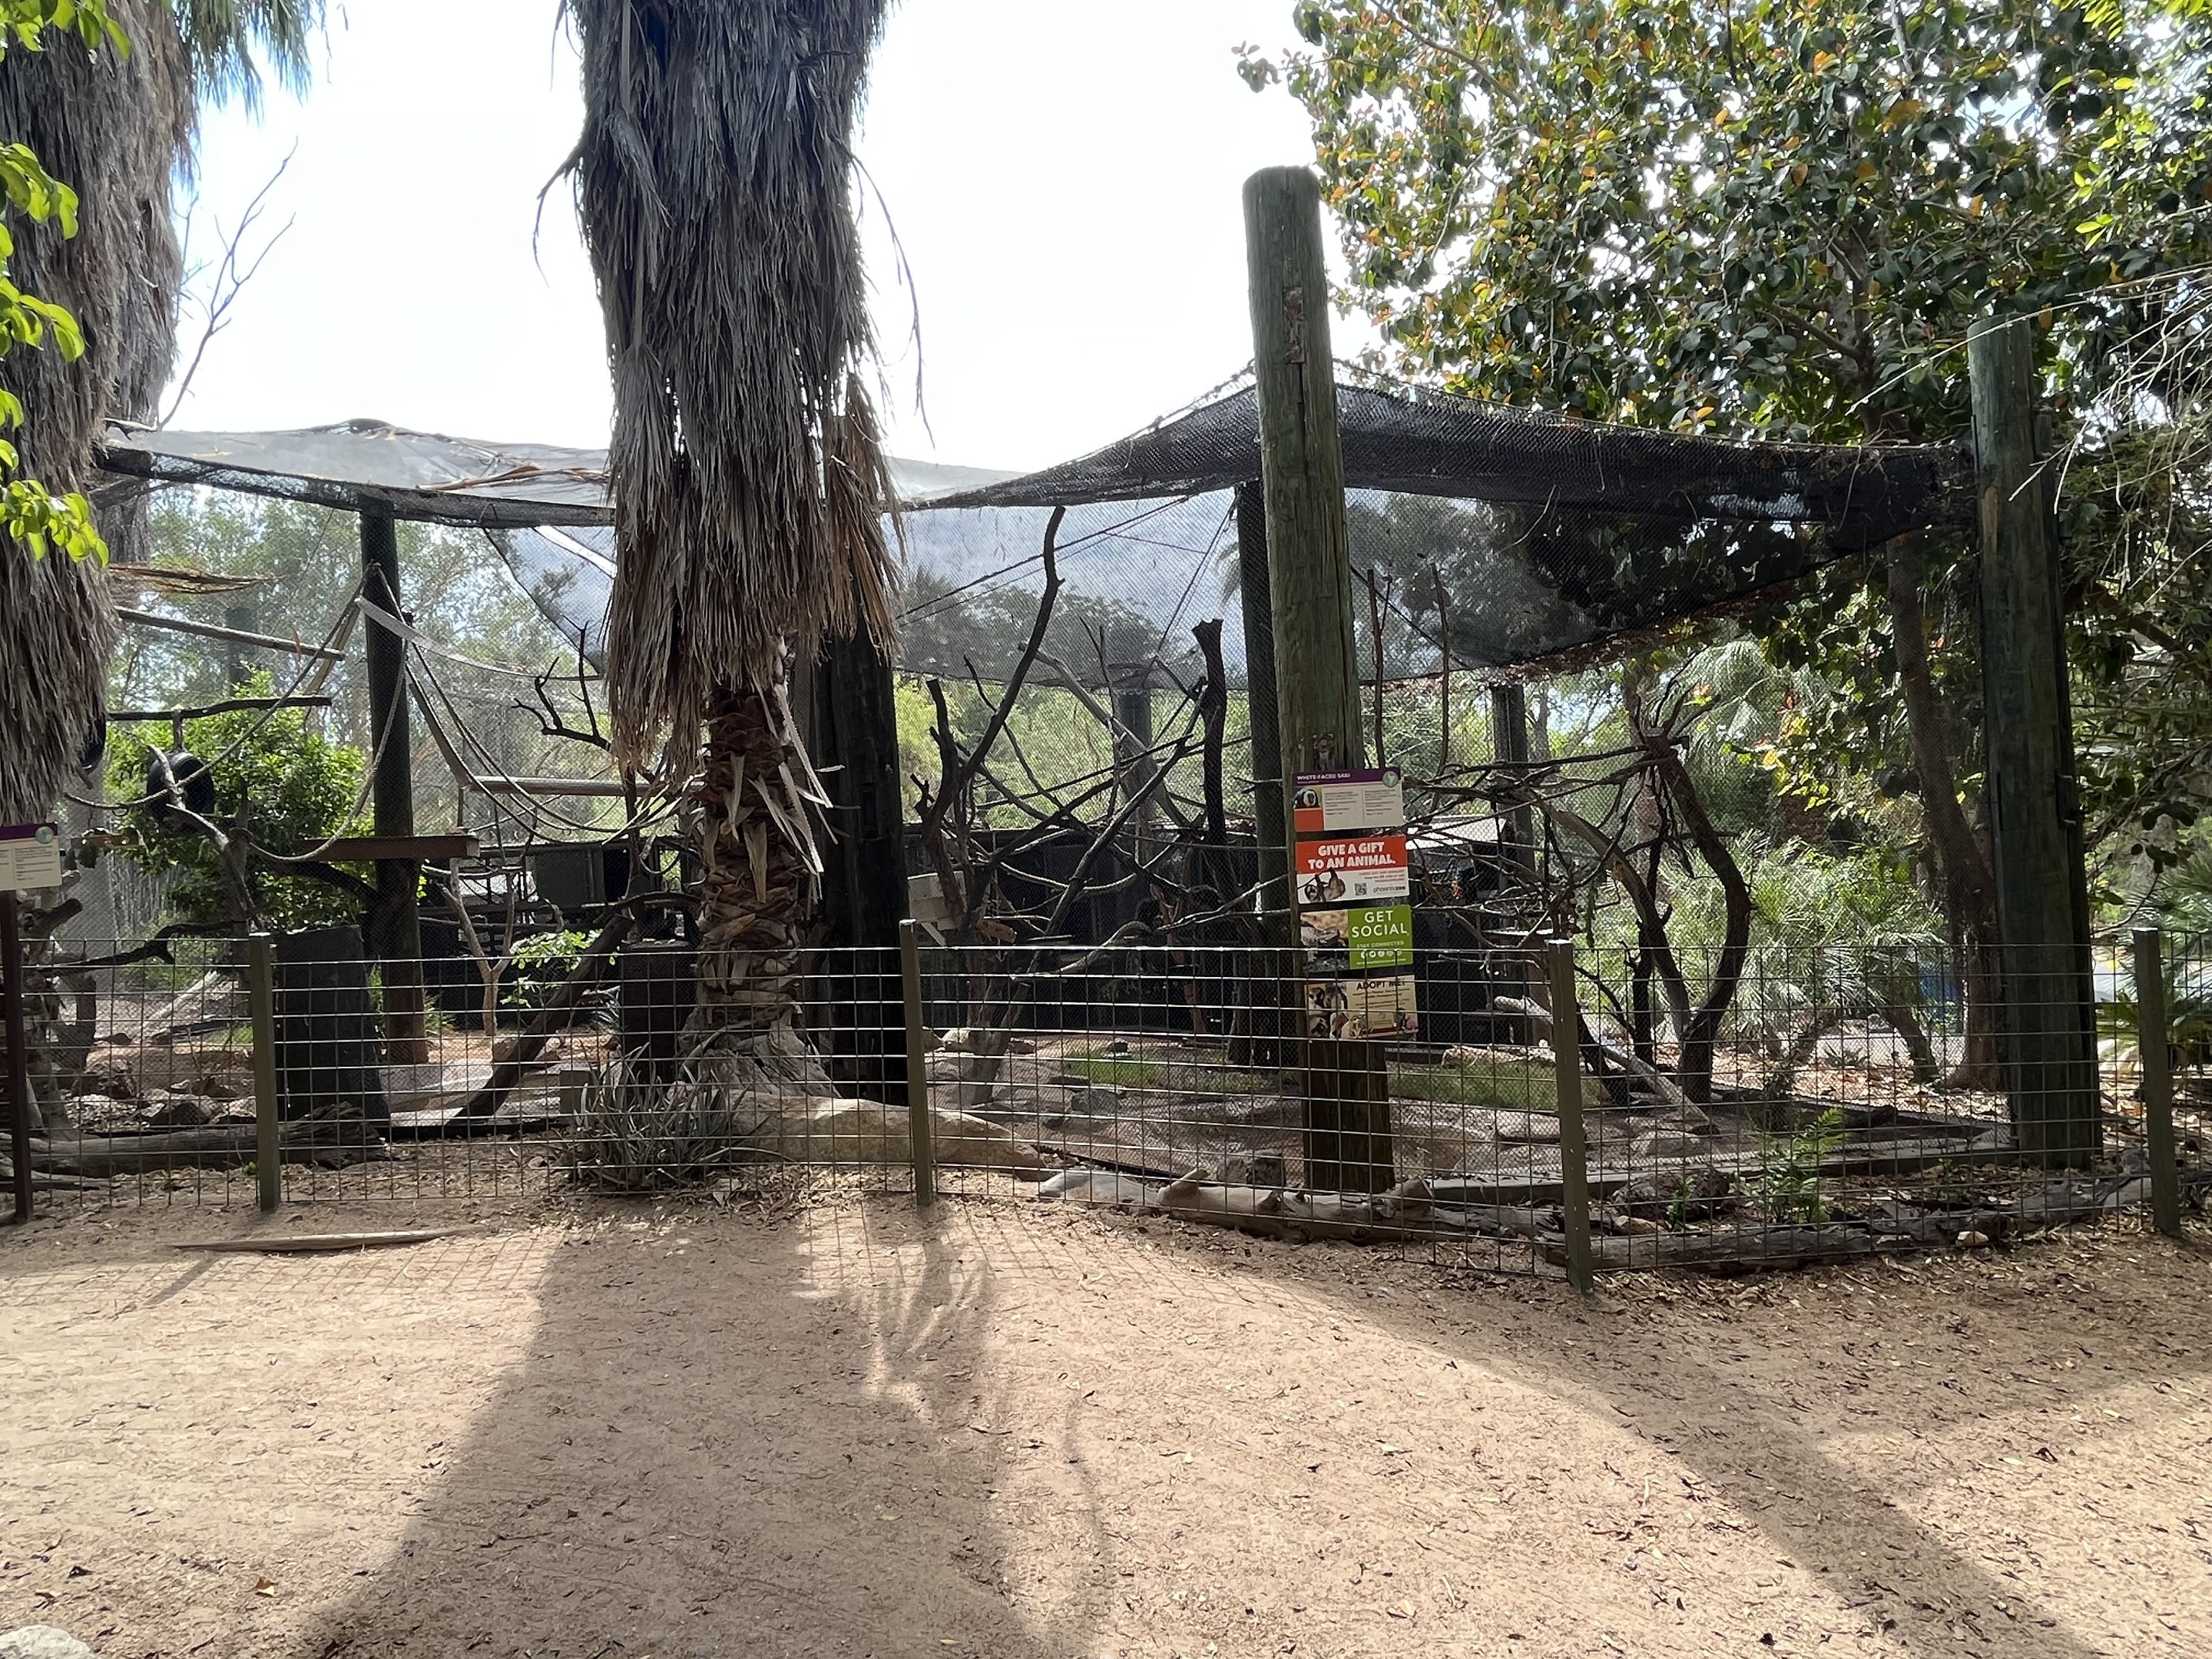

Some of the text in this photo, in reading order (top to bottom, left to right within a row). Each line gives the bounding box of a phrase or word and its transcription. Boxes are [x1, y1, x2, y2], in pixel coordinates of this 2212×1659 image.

[1318, 842, 1385, 856] GIVE A GIFT
[1307, 854, 1396, 869] TO AN ANIMAL.
[1364, 910, 1393, 923] GET
[1356, 981, 1386, 990] ADOPT
